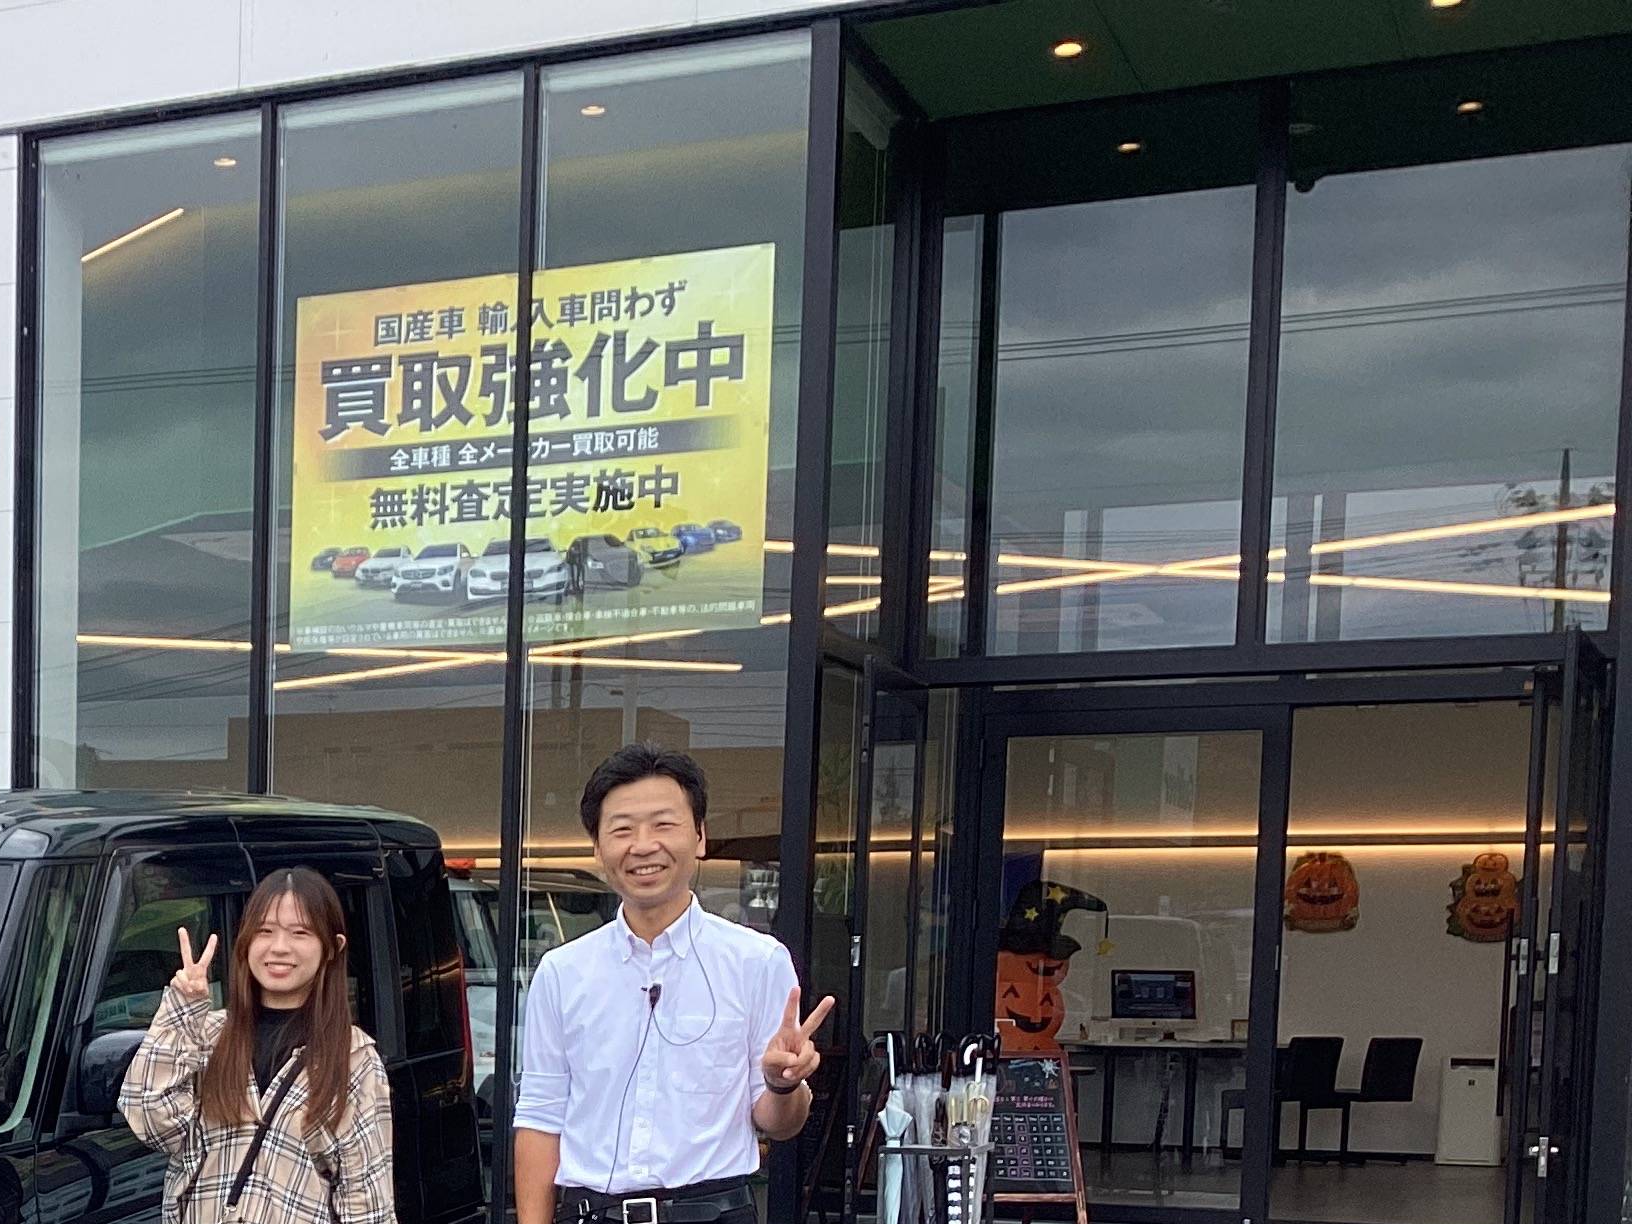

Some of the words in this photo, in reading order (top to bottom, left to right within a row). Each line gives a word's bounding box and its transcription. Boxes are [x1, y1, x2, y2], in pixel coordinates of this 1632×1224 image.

[373, 306, 466, 346] 国産車
[318, 319, 746, 441] 買取強化中
[389, 445, 452, 472] 全車種
[369, 464, 680, 530] 無料査定実施中
